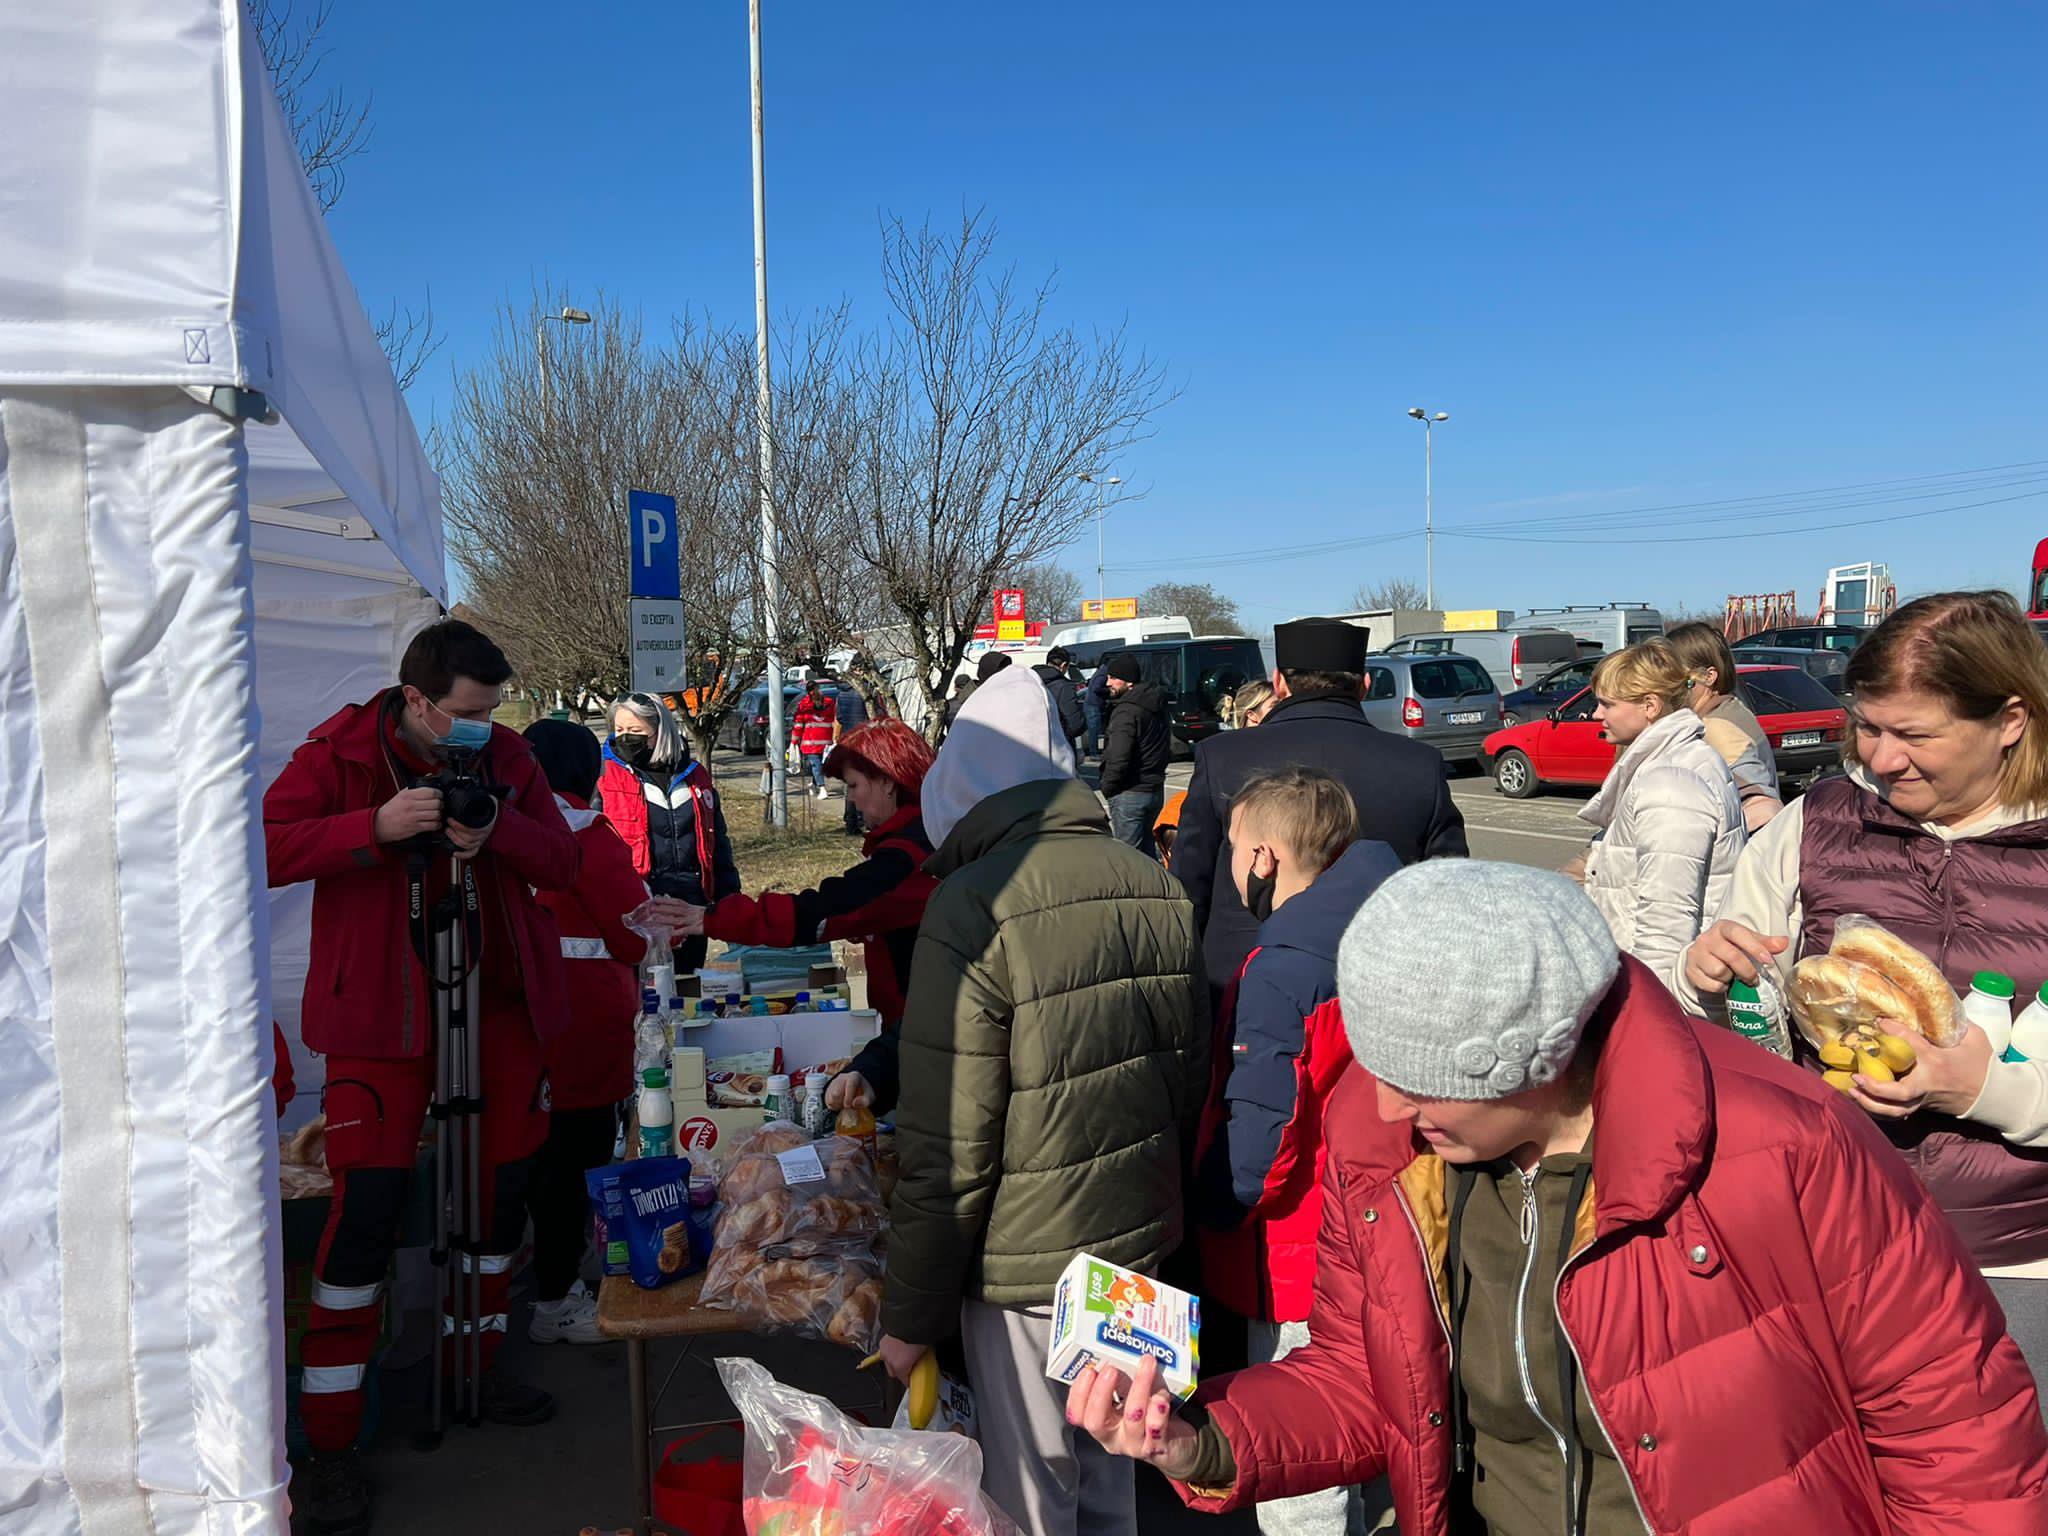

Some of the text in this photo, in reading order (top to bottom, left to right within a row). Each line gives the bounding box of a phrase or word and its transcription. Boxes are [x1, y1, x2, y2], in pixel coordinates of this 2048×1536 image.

[641, 509, 666, 568] P
[410, 882, 421, 919] Canon
[1732, 1015, 1764, 1030] Sana
[685, 1121, 707, 1153] 7
[696, 1122, 714, 1148] DAYS
[1102, 1325, 1174, 1364] Salviasept
